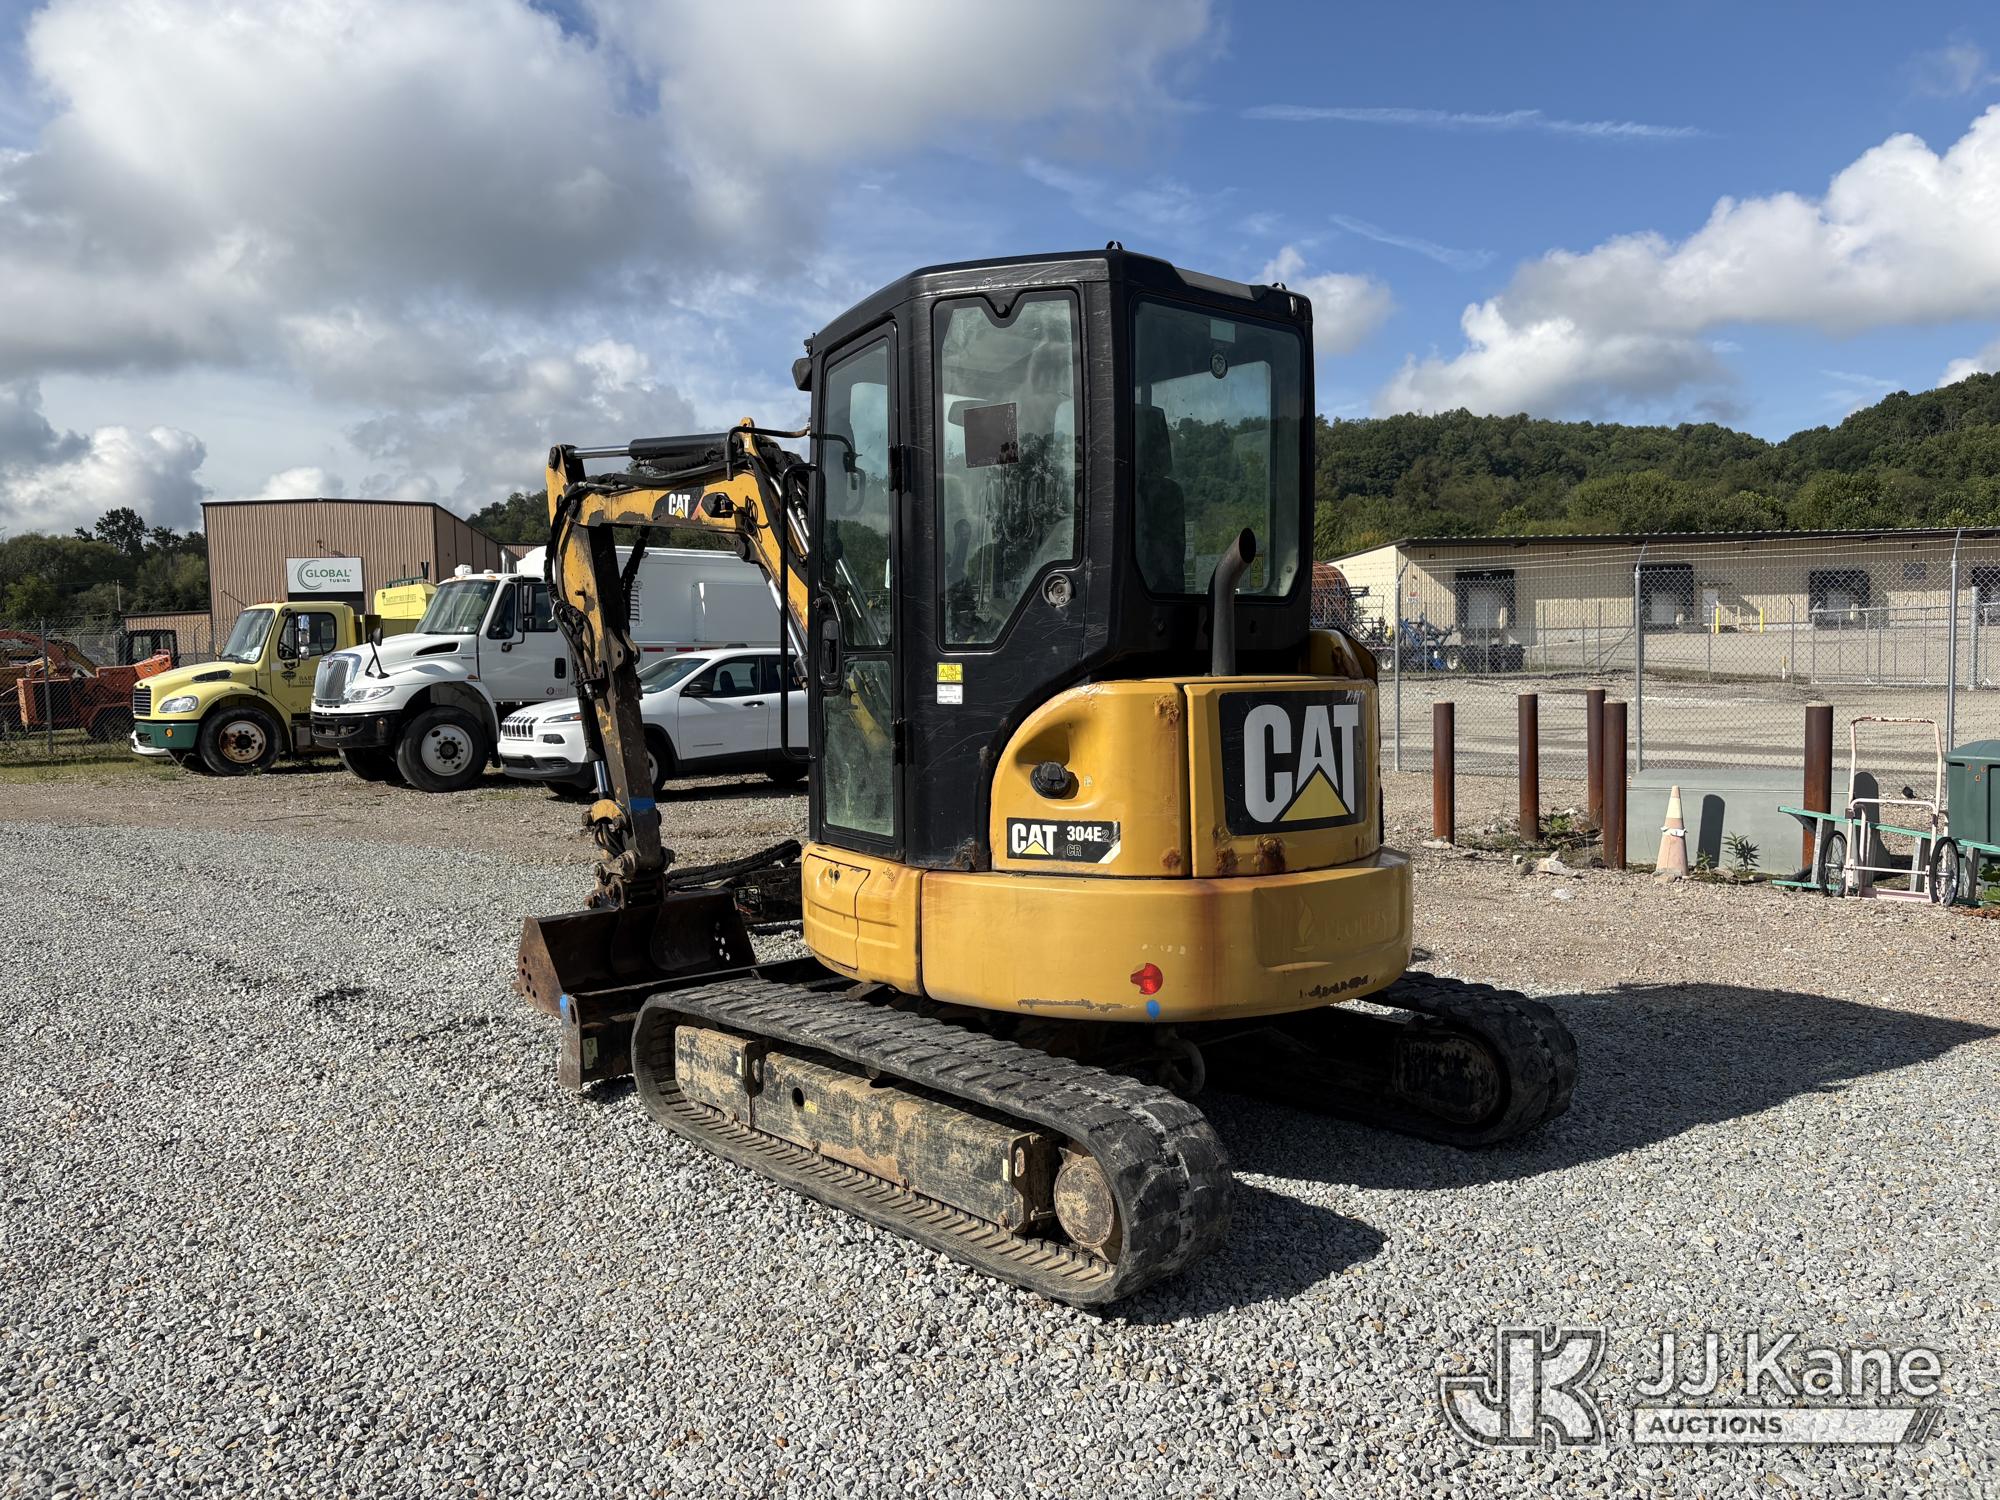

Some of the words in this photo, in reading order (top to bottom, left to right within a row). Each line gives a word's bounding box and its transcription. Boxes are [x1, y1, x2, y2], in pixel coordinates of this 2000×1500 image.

[668, 493, 691, 518] CAT
[305, 569, 350, 578] GLOBAL
[1243, 704, 1359, 823] CAT
[1011, 823, 1058, 855] CAT
[1066, 825, 1110, 843] 304E2
[1066, 844, 1082, 856] CR
